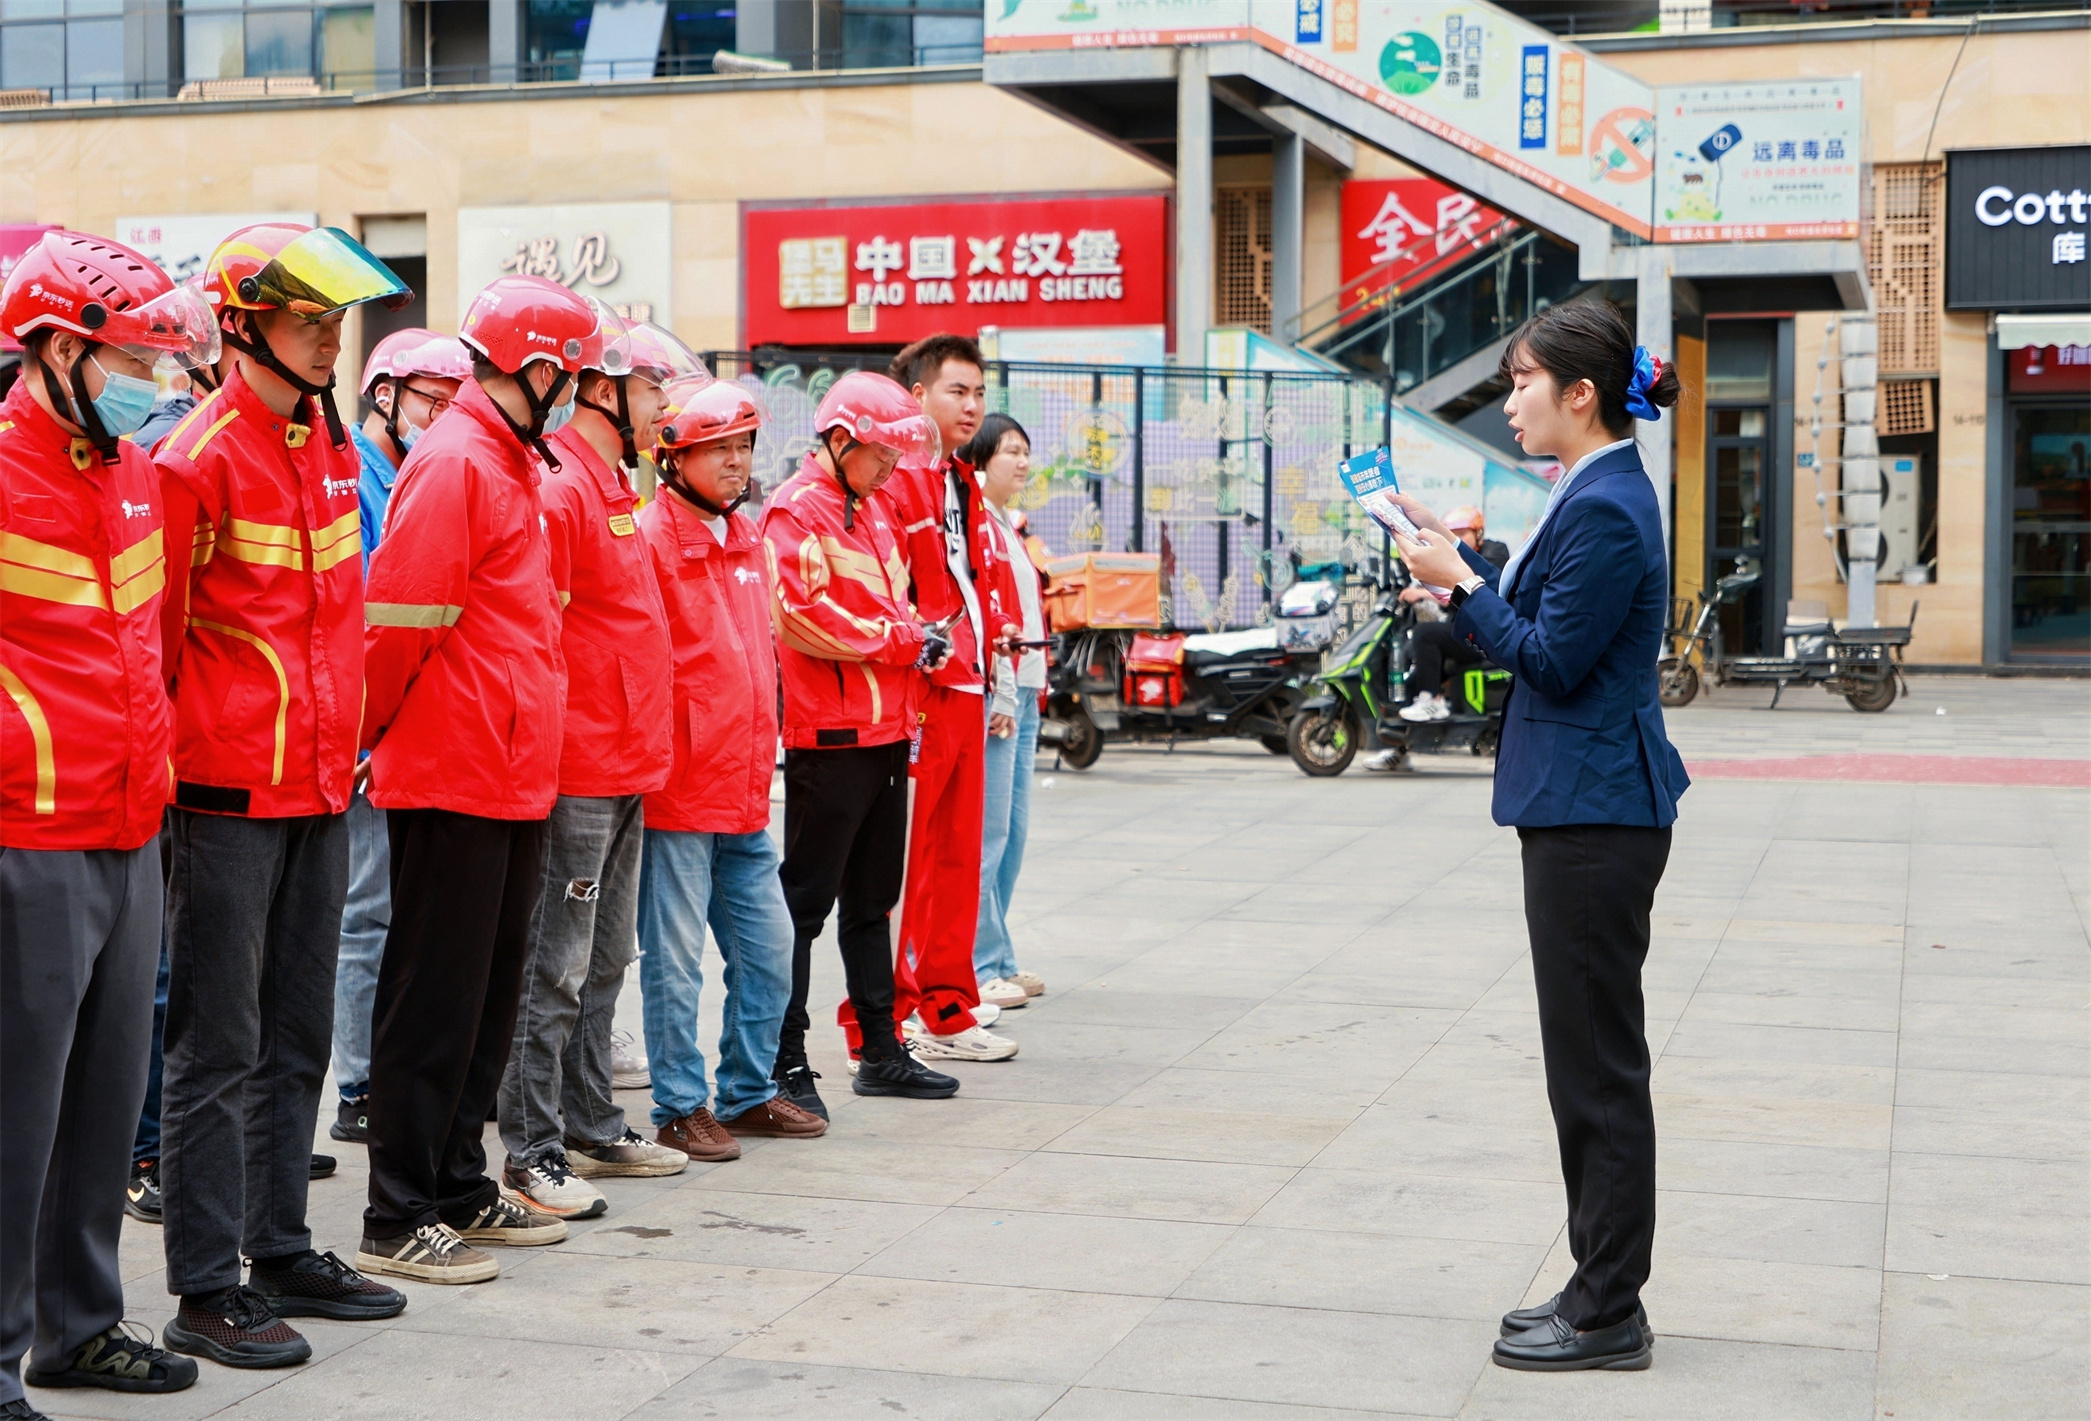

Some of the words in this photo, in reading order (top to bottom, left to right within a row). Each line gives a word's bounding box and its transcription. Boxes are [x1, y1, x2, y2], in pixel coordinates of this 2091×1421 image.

[1752, 138, 1846, 163] 远离毒品
[1975, 186, 2091, 227] Cott
[1357, 191, 1513, 264] 全民
[500, 231, 621, 288] 遇见
[2052, 231, 2085, 264] 库
[856, 281, 905, 306] BAO
[916, 280, 956, 305] MA
[966, 278, 1028, 303] XIAN
[1040, 275, 1124, 302] SHENG
[764, 364, 859, 430] 66
[332, 477, 358, 490] 京东秒
